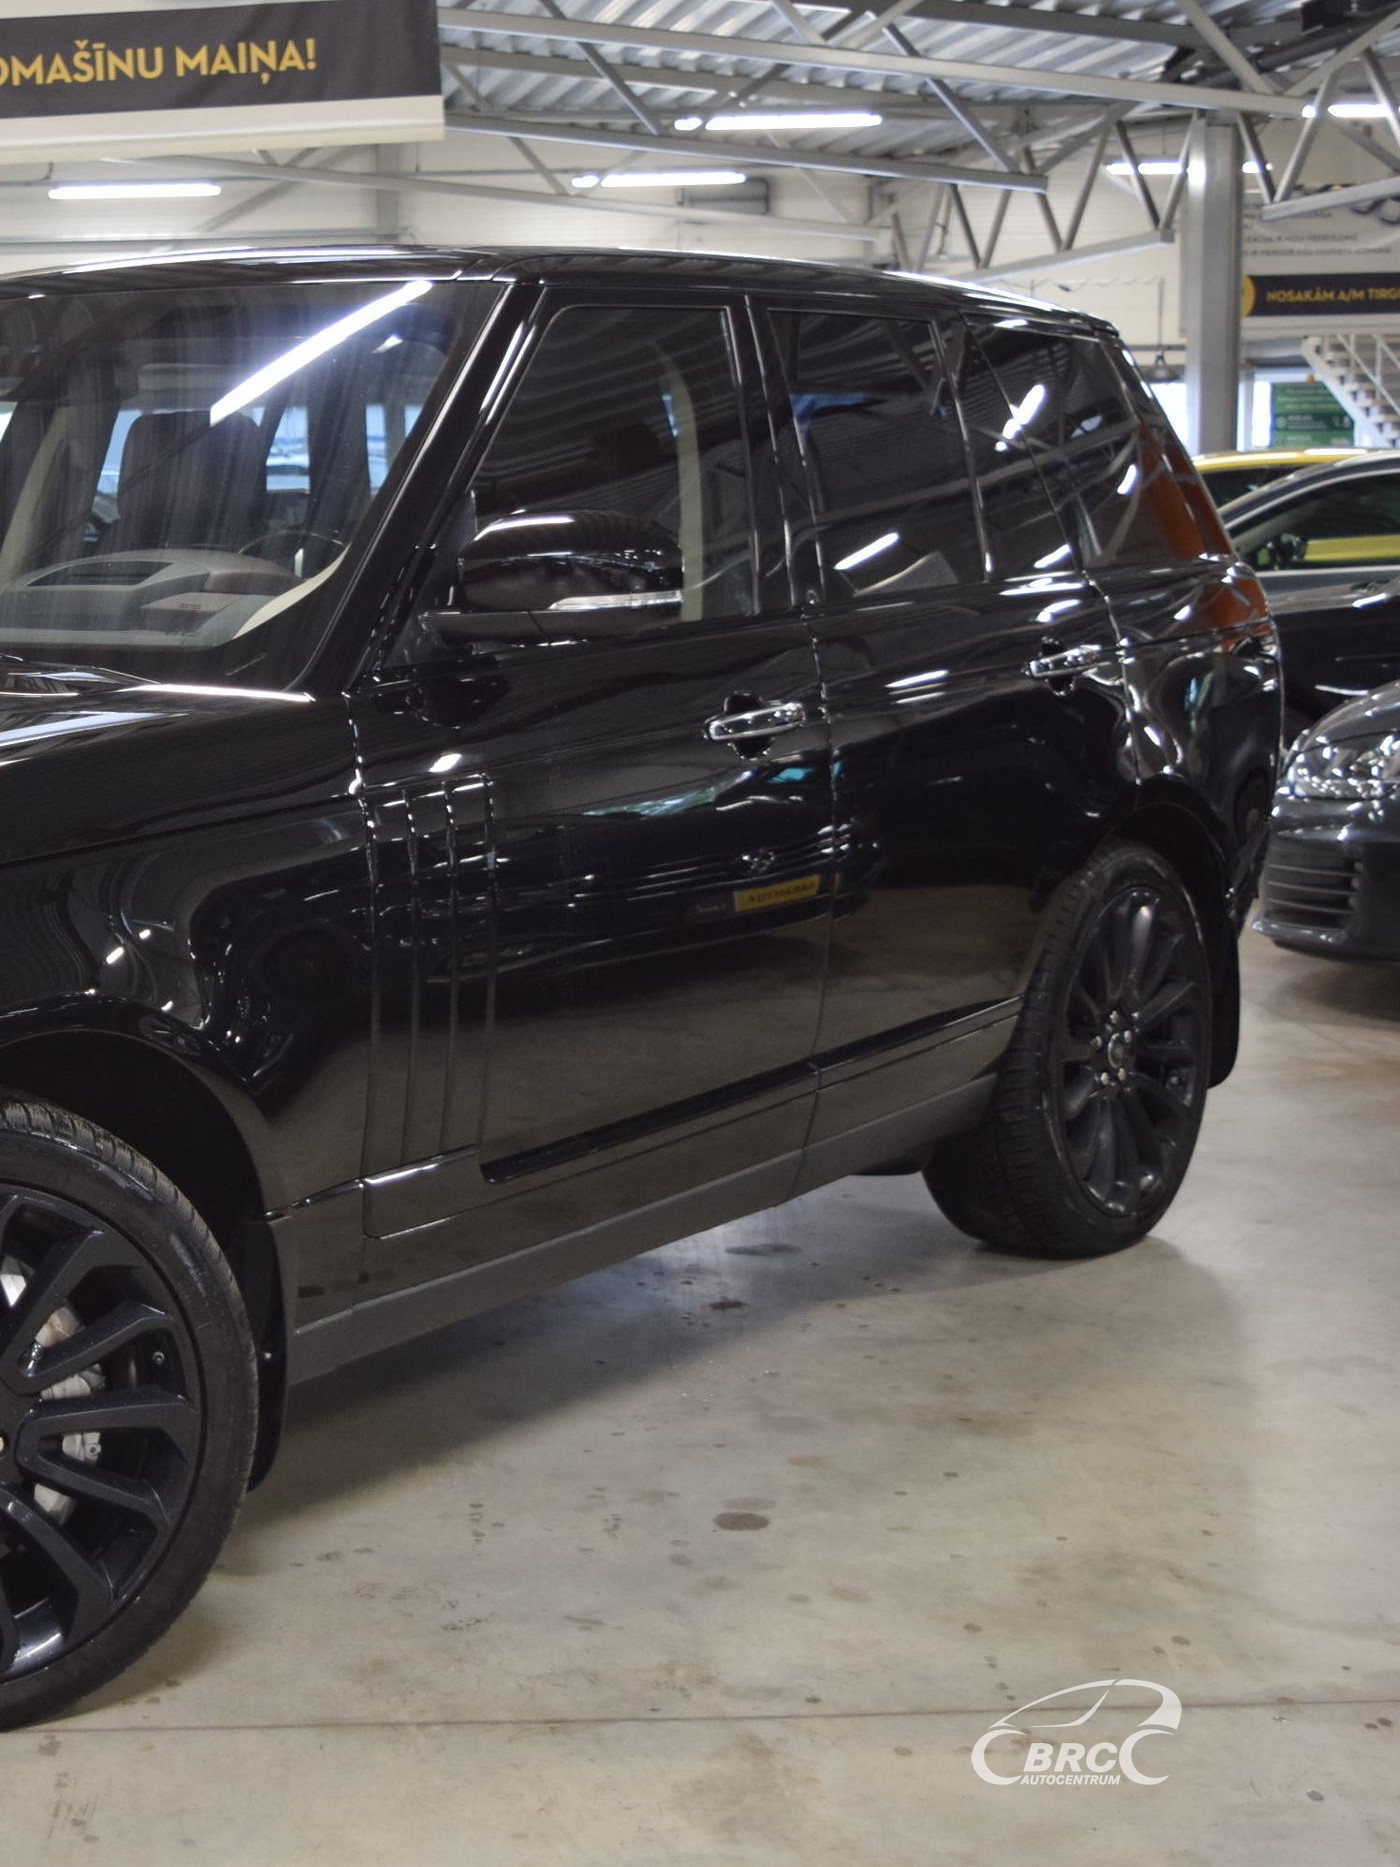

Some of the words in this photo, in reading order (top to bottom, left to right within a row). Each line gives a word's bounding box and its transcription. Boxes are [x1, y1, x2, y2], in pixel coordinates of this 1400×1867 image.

[175, 38, 318, 85] MAIŅA!
[1266, 286, 1335, 302] NOSAKĀM
[1337, 288, 1365, 303] A/M
[1367, 287, 1400, 301] TIRG
